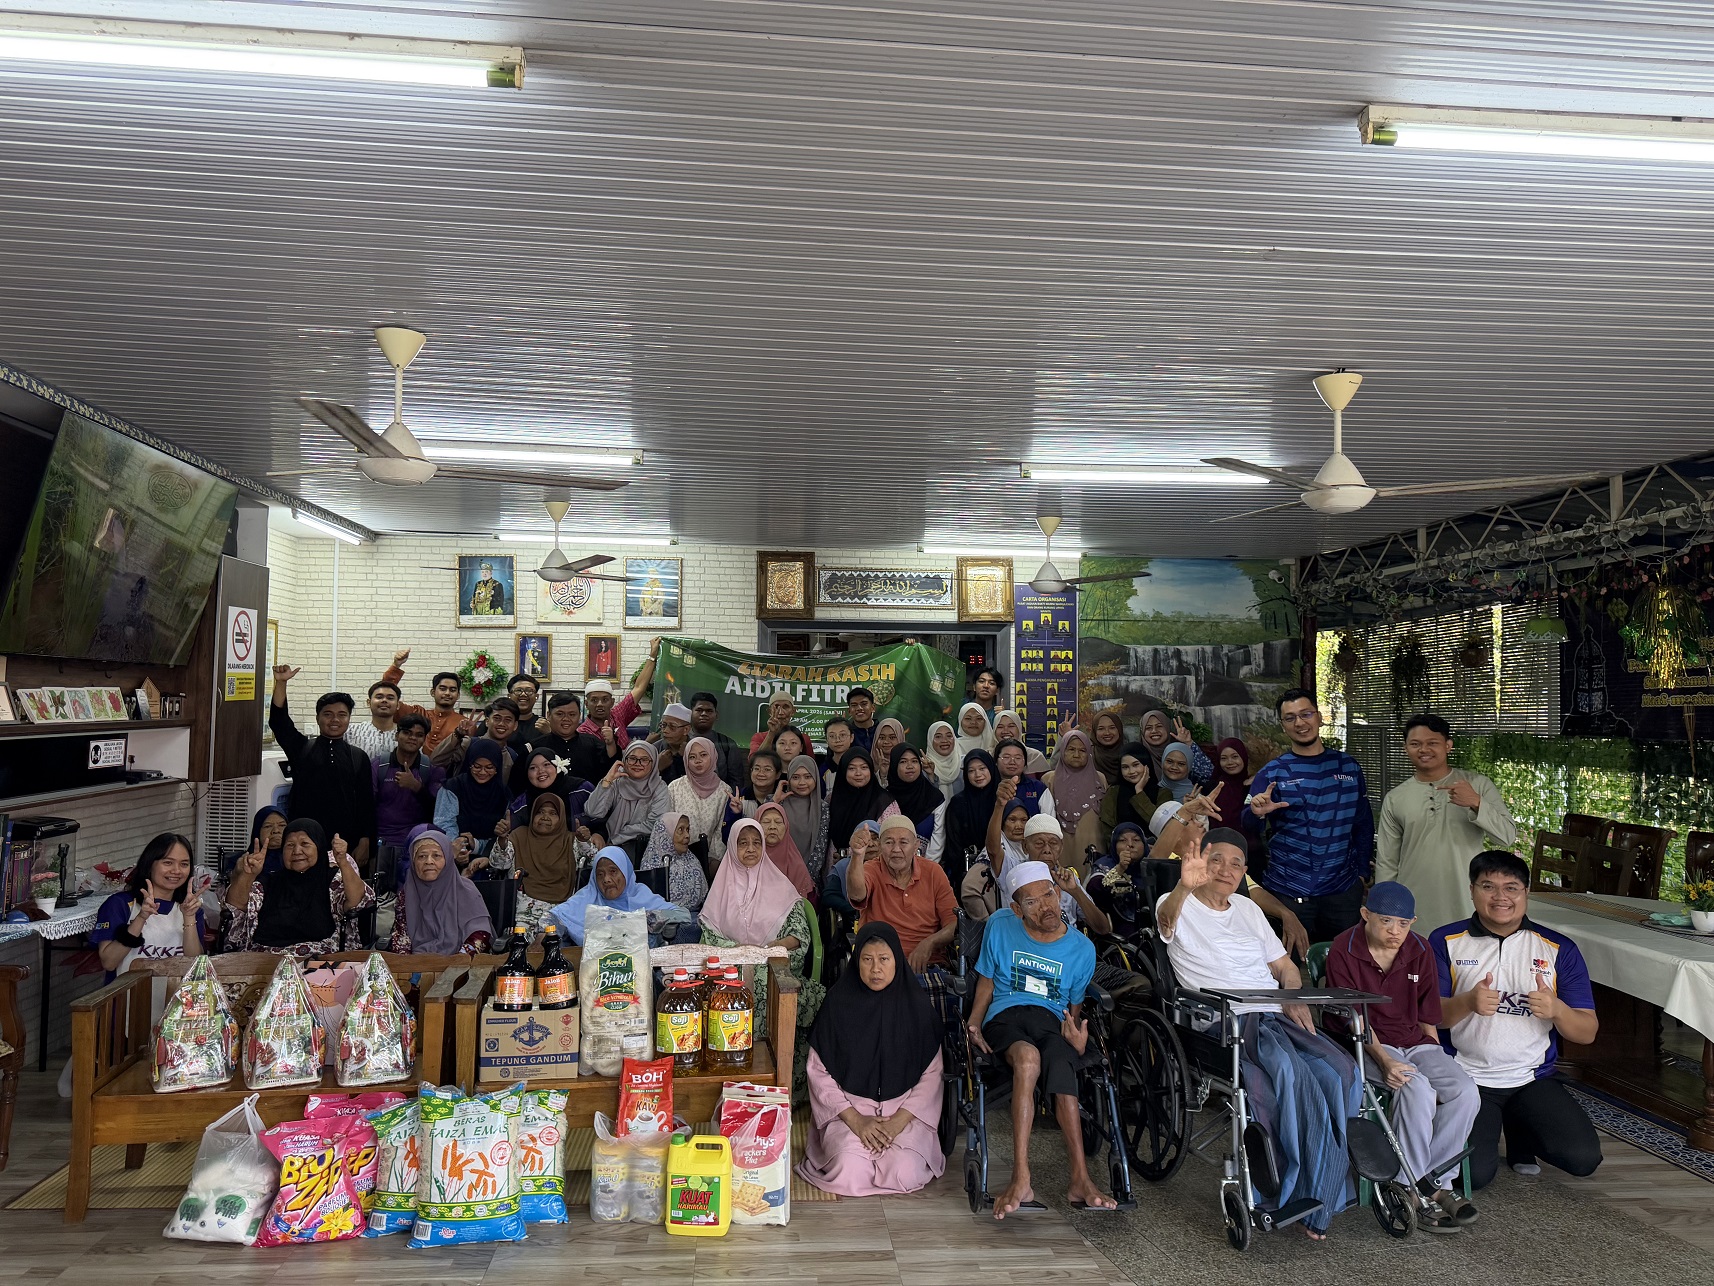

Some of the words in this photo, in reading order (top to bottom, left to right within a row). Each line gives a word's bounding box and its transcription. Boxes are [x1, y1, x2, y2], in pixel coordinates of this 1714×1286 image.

[738, 661, 824, 682] ZIARAH
[826, 663, 896, 682] KASIH
[1018, 958, 1056, 974] ANTIONI
[594, 970, 636, 992] Bihun
[672, 1016, 687, 1024] Saji
[722, 1014, 738, 1022] Saji
[530, 1054, 571, 1063] GANDUM
[636, 1100, 656, 1112] KAW
[454, 1116, 486, 1126] BERAS
[429, 1128, 466, 1138] FAIZA
[474, 1122, 509, 1136] EMAS
[318, 1191, 347, 1211] PARFUM
[680, 1190, 714, 1204] KUAT
[220, 1200, 242, 1211] PRAI
[215, 1207, 240, 1220] GULA
